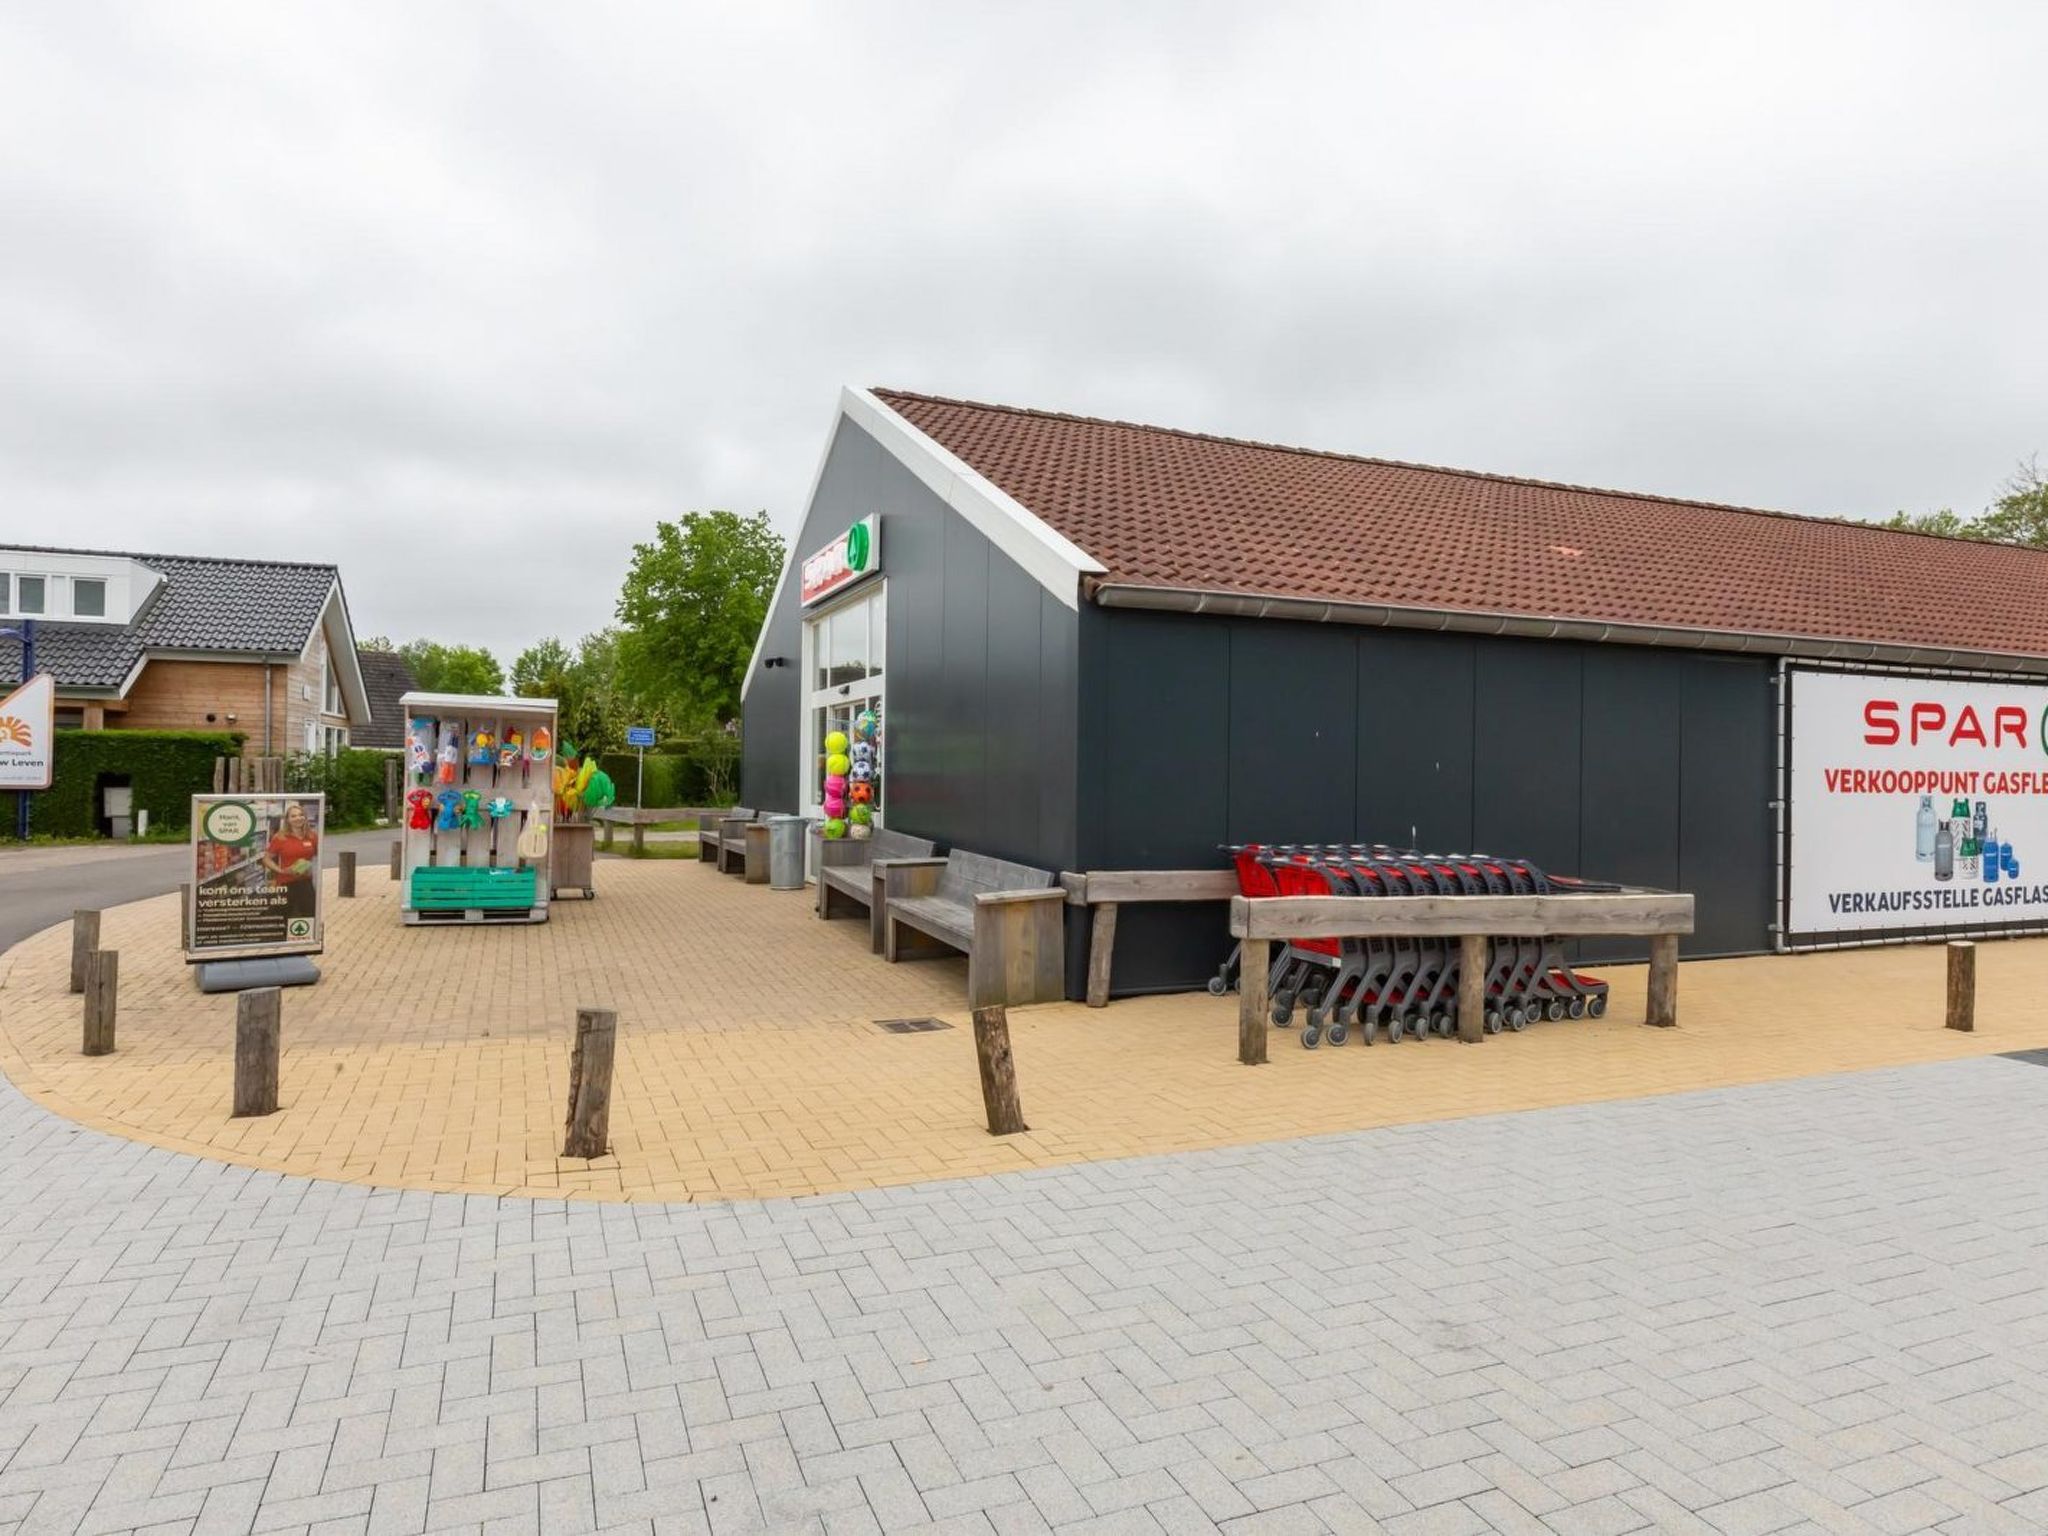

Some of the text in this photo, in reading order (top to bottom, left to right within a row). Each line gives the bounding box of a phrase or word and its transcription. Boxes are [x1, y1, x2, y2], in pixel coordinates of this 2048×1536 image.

[1864, 700, 2027, 748] SPAR
[1825, 768, 2048, 794] VERKOOPPUNT GASFLE
[198, 896, 288, 907] versterken als
[199, 885, 228, 895] kom
[256, 885, 288, 894] team
[1829, 885, 2048, 913] VERKAUFSSTELLE GASFLAS
